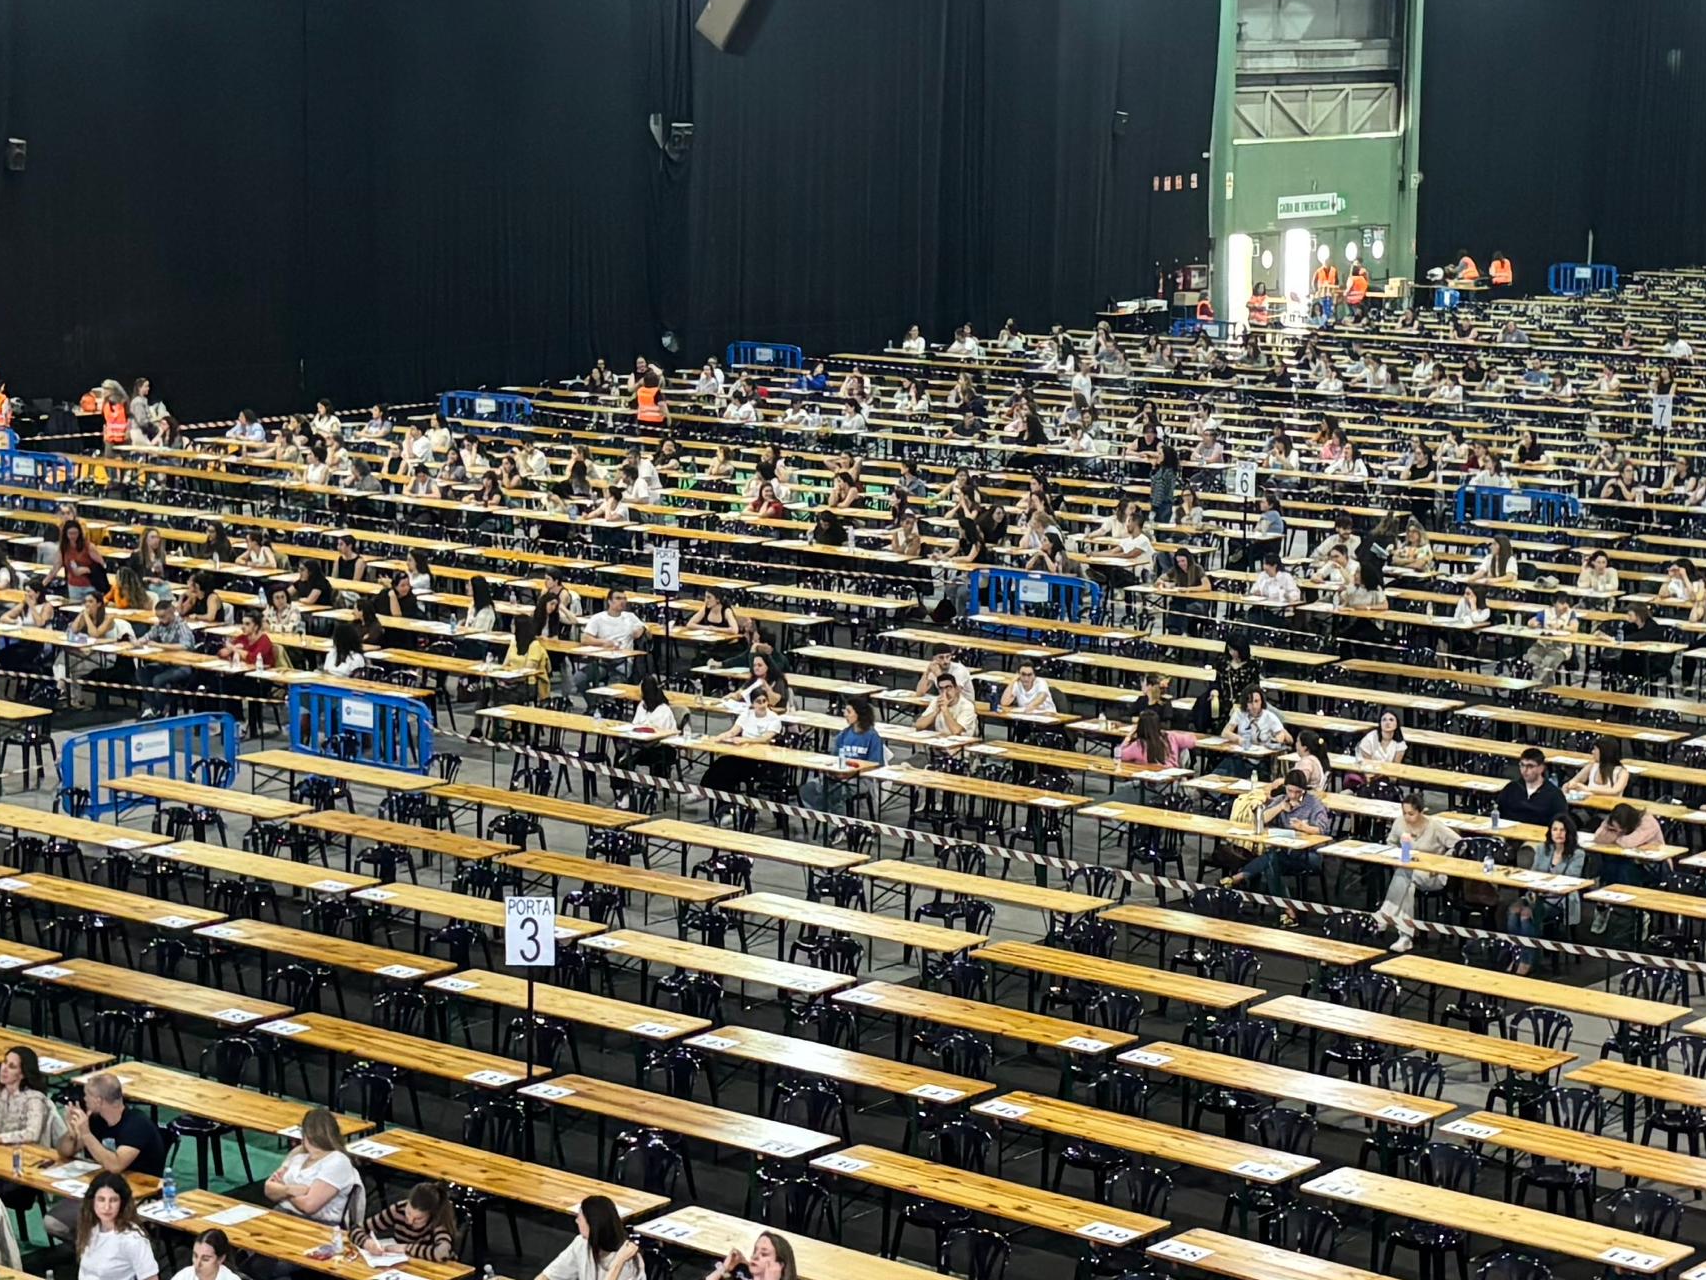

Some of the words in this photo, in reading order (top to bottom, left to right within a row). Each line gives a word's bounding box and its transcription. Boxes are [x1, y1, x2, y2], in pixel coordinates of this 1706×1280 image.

[1658, 404, 1667, 423] 7
[1241, 472, 1249, 493] 6
[660, 562, 671, 587] 5
[508, 899, 551, 915] PORTA
[519, 917, 541, 963] 3
